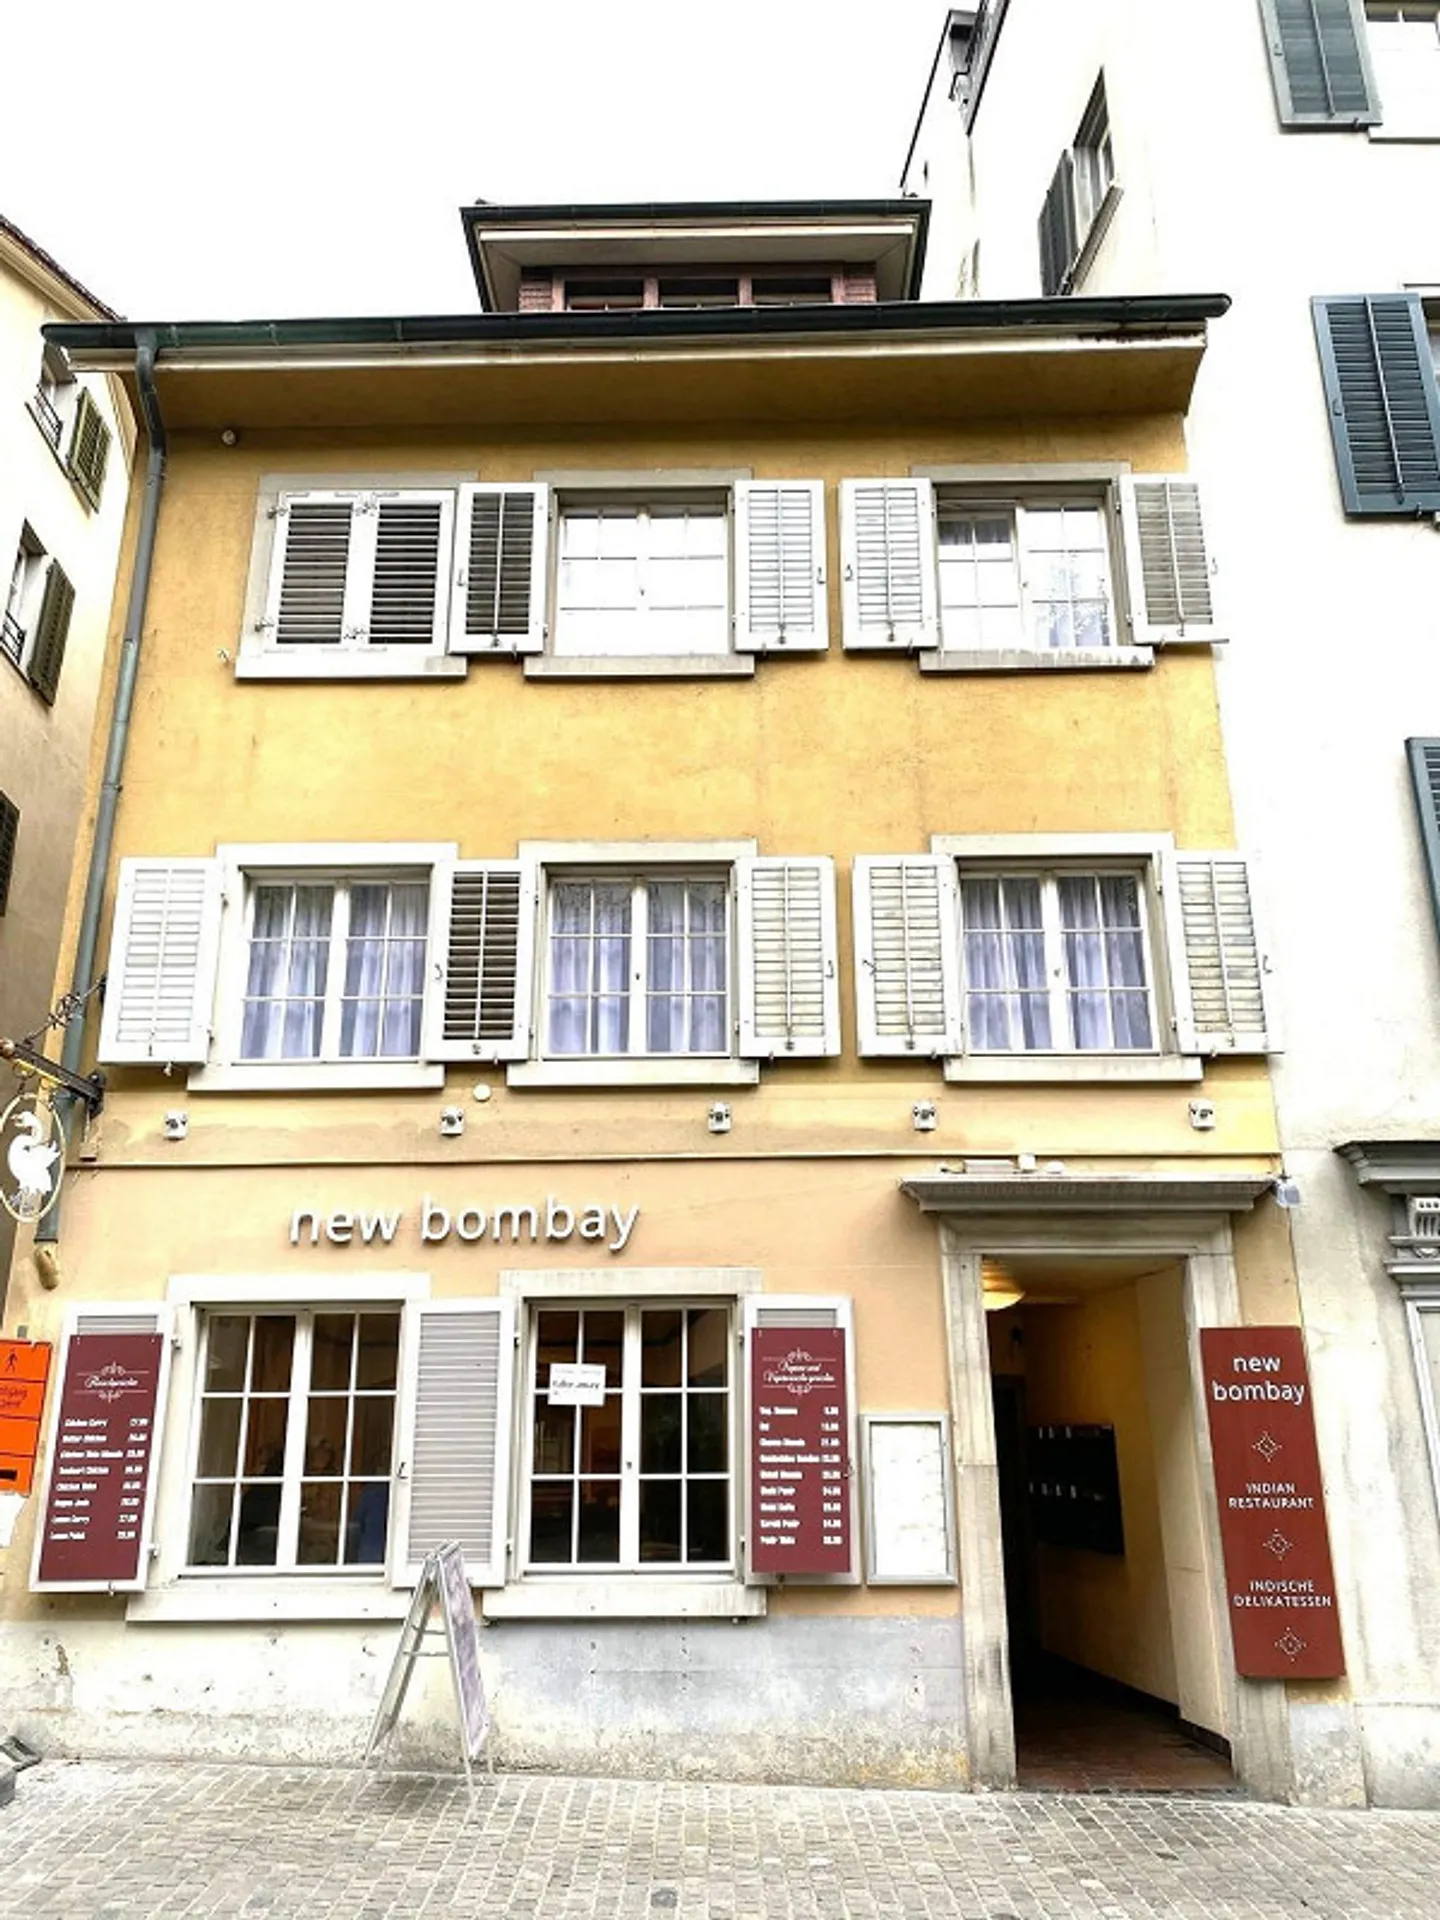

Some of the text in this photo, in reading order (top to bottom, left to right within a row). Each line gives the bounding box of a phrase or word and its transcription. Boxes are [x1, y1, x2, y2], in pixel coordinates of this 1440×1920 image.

[289, 1193, 640, 1253] new bombay
[1232, 1356, 1281, 1372] new
[1211, 1379, 1305, 1406] bombay
[1246, 1483, 1296, 1495] INDIAN
[1228, 1497, 1314, 1509] RESTAURANT
[1249, 1580, 1315, 1593] INDISCHE
[1233, 1594, 1332, 1608] DELIKATESSEN
